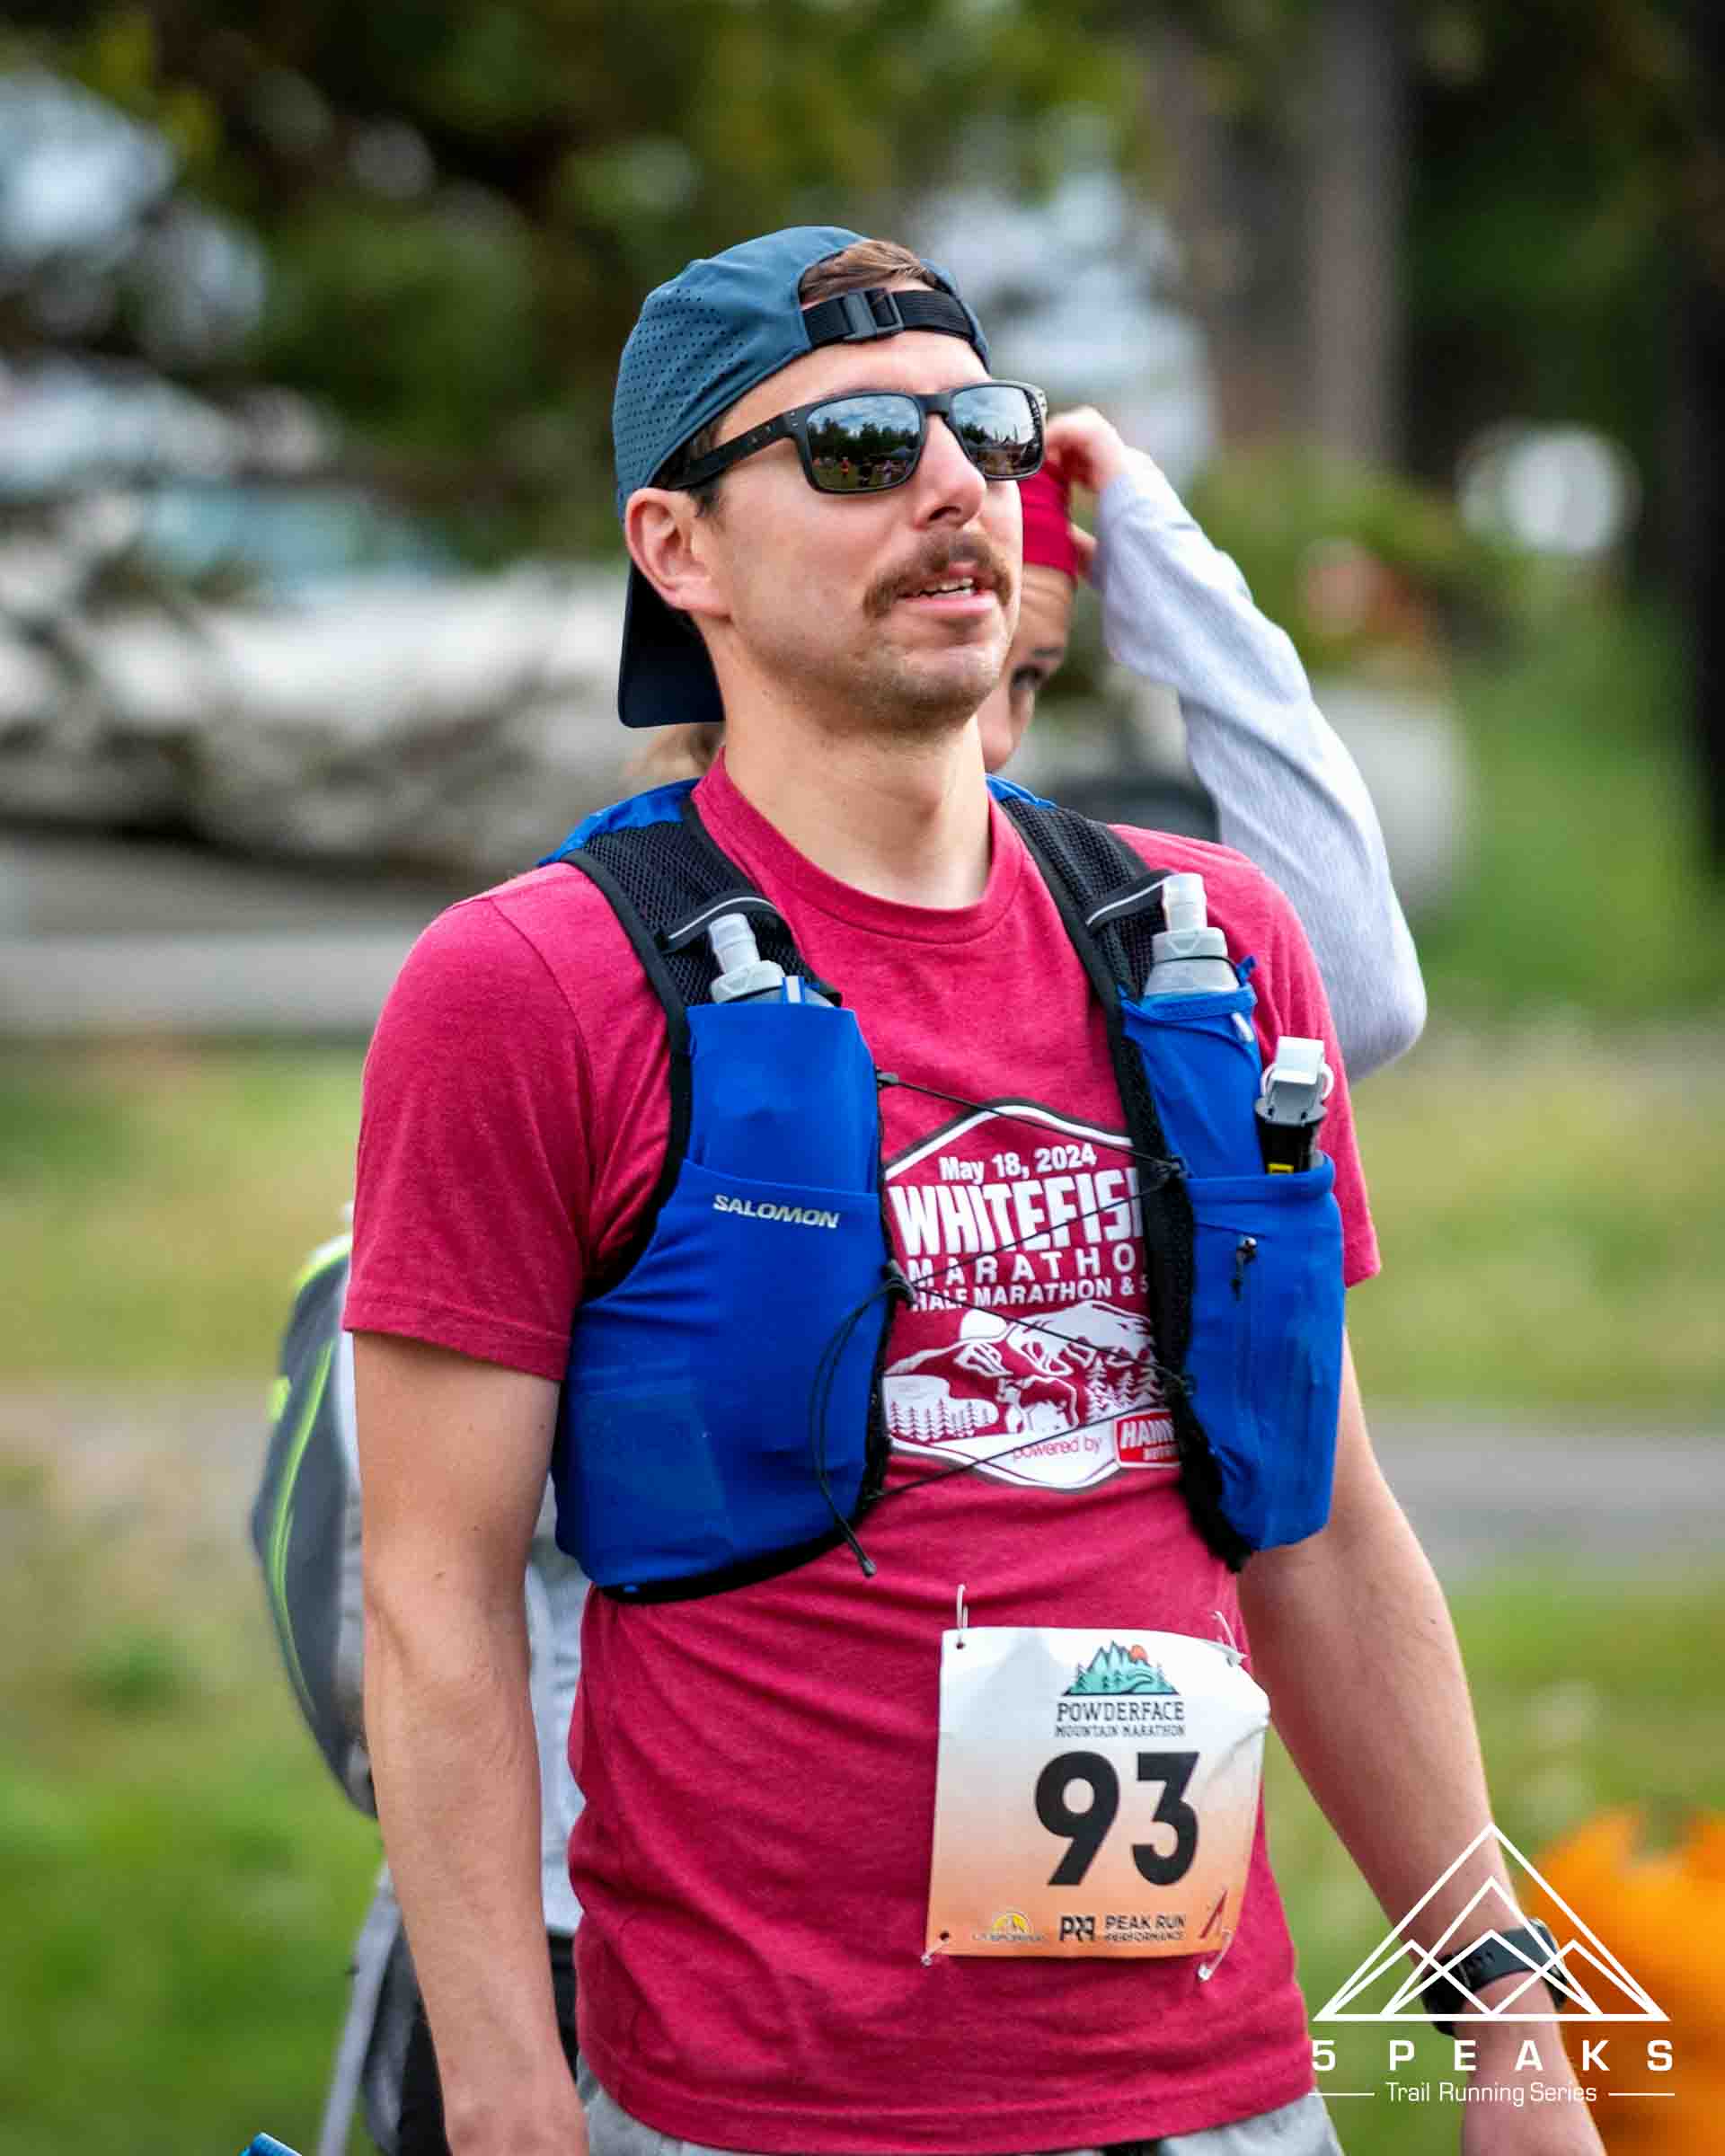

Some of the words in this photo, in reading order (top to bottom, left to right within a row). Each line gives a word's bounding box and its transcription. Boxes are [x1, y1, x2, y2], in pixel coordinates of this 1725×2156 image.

[939, 1156, 985, 1184] May
[992, 1152, 1030, 1179] 18,
[1035, 1144, 1097, 1172] 2024
[712, 1194, 840, 1229] SALOMON
[907, 1243, 1147, 1287] MARATHO
[973, 1278, 1111, 1306] MARATHON
[1120, 1276, 1135, 1296] &
[1013, 1438, 1078, 1461] powered
[1084, 1436, 1101, 1454] by
[1057, 1701, 1185, 1722] POWDERFACE
[1055, 1725, 1118, 1738] MOUNTAIN
[1123, 1724, 1186, 1737] MARATHON
[1035, 1751, 1200, 1886] 93
[1104, 1914, 1151, 1931] PEAK
[1154, 1914, 1187, 1929] RUN
